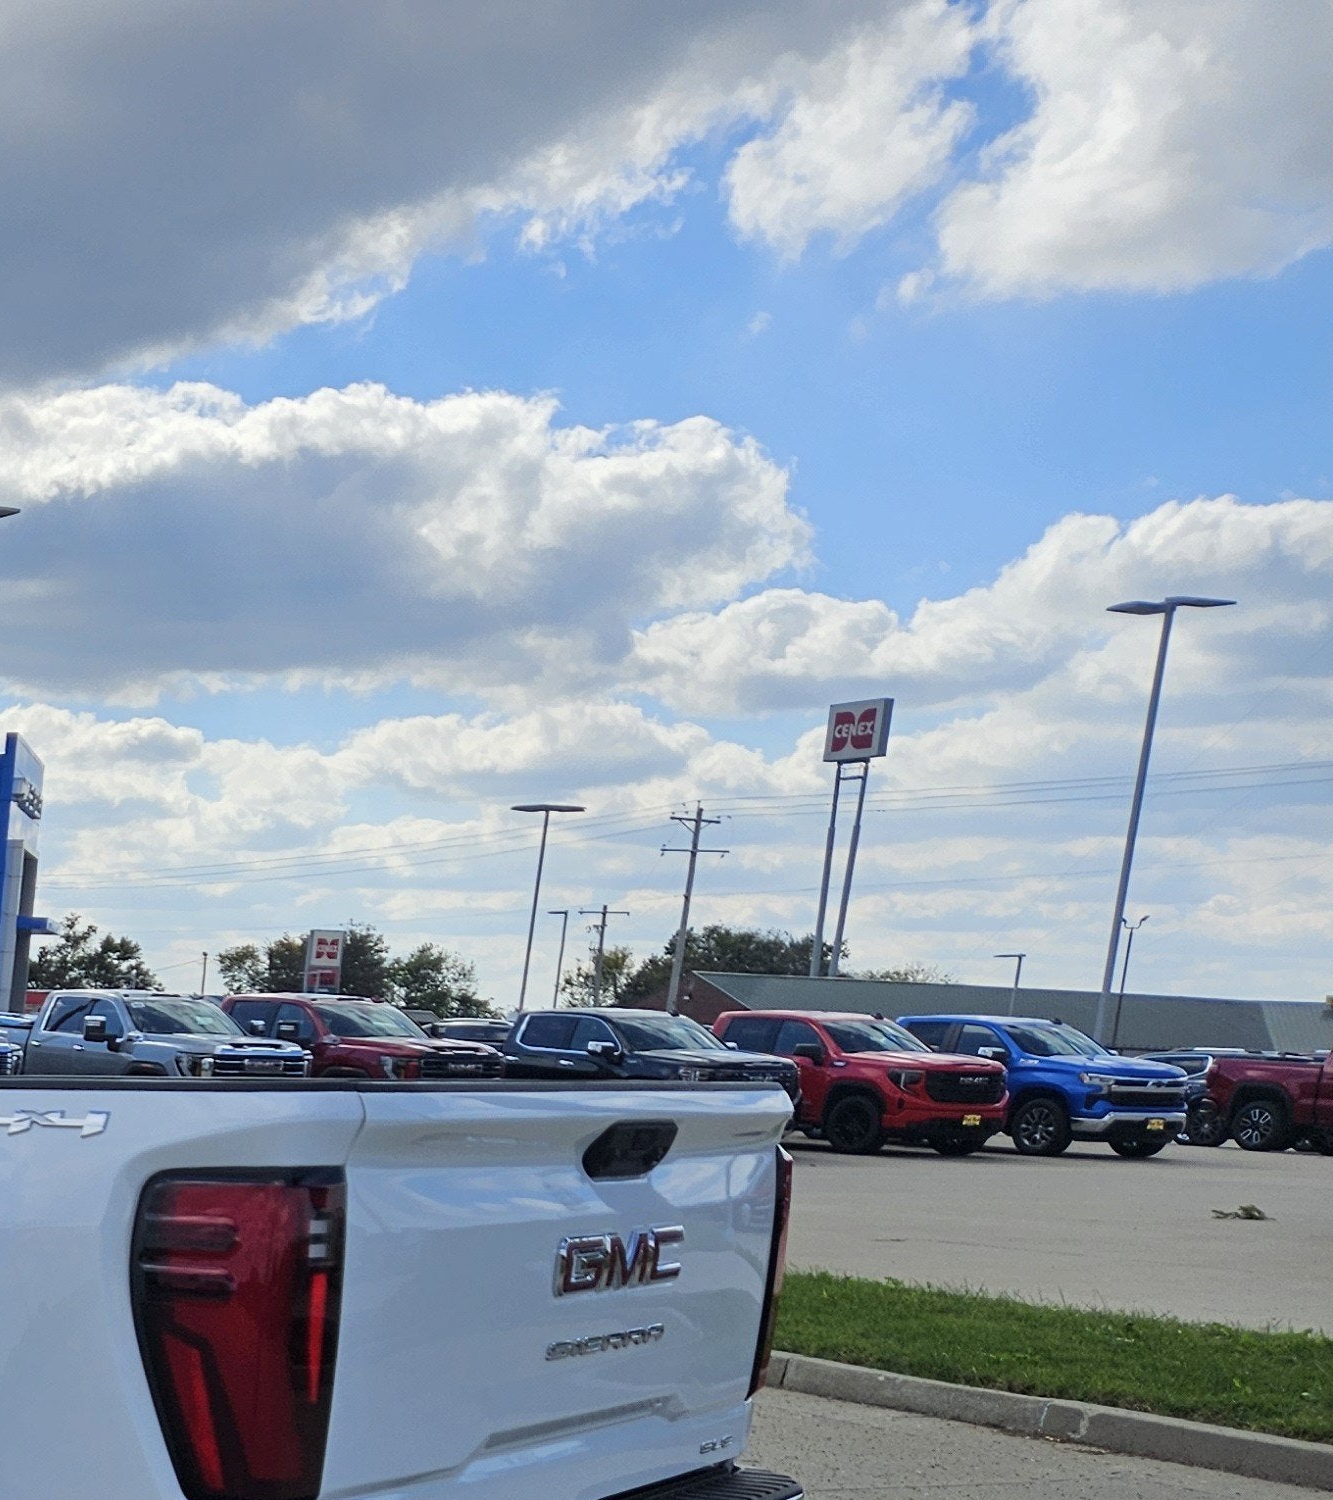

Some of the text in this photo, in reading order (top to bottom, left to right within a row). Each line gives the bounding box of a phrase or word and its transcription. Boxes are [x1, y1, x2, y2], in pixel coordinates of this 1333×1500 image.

[835, 721, 874, 738] CENEX
[553, 1225, 684, 1297] GMC
[545, 1323, 664, 1361] SIERRA
